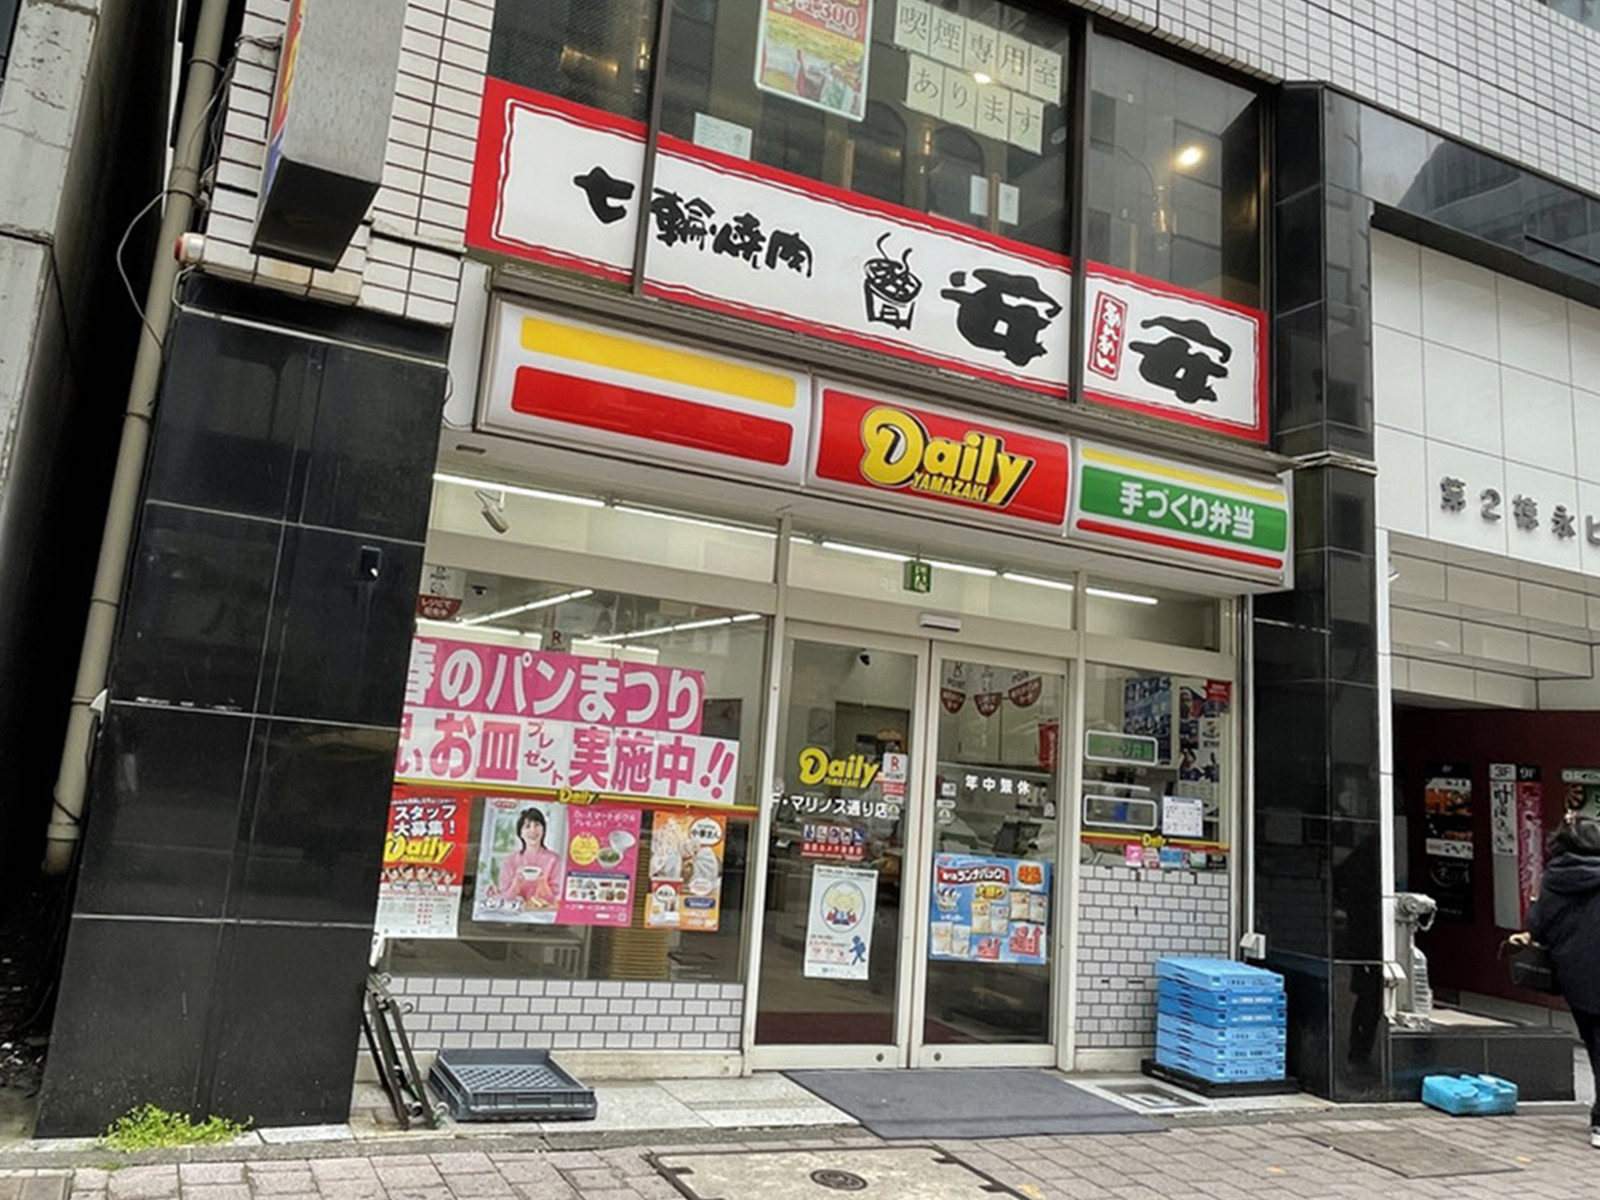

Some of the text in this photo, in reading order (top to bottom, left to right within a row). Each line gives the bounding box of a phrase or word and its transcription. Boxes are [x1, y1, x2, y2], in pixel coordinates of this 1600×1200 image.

[902, 5, 1058, 90] 喫煙専用室
[912, 69, 1040, 133] あります
[573, 166, 813, 278] 七輪焼肉
[860, 406, 1035, 508] Daily
[912, 471, 988, 500] YAMAZAKI
[1119, 480, 1255, 540] 手づくり弁当
[799, 747, 880, 789] Daily
[965, 774, 1031, 795] 年中無休
[395, 804, 457, 821] スタッフ
[558, 787, 598, 805] Daily
[383, 832, 455, 864] Daily
